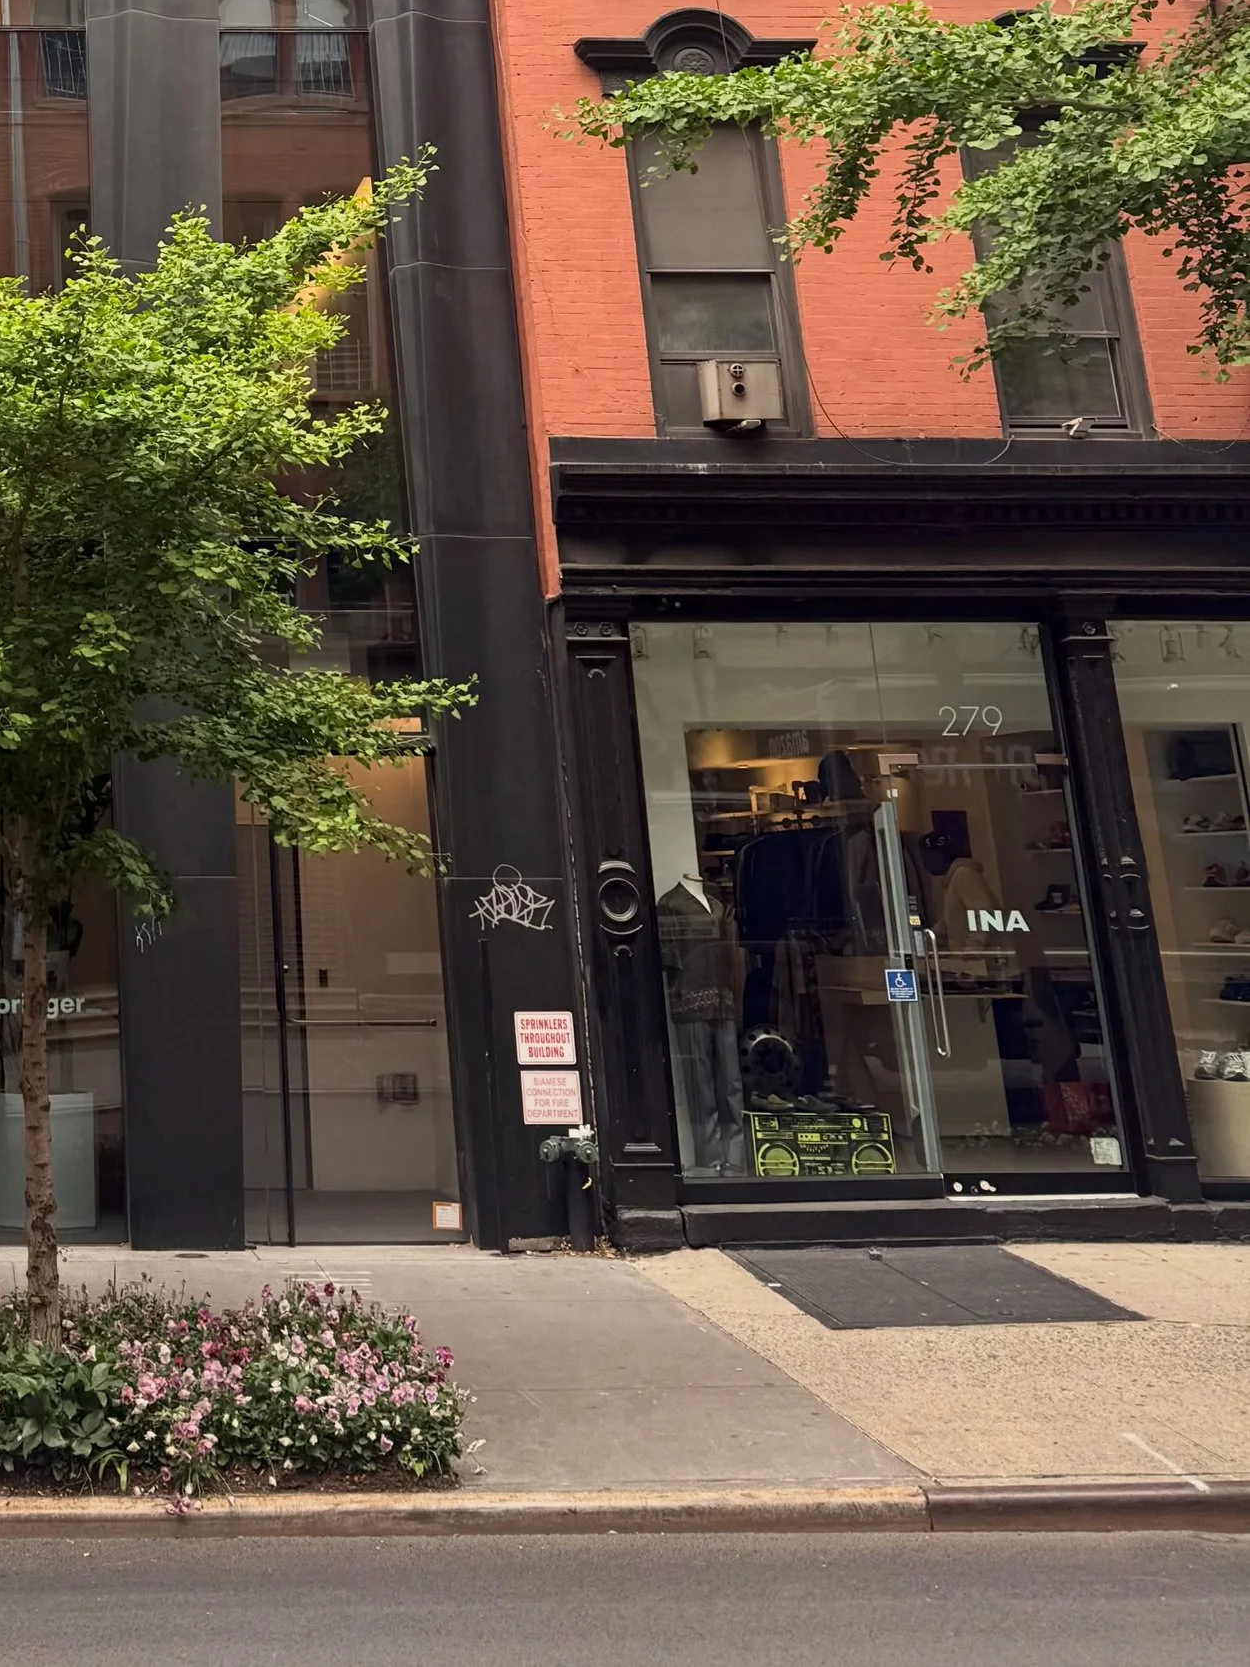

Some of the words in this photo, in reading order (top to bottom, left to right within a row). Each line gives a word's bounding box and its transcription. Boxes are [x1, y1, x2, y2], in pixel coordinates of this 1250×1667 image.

[939, 706, 1003, 736] 279
[966, 909, 1031, 932] INA
[520, 1018, 568, 1030] SPRINKLERS
[519, 1032, 570, 1044] THROUGHOUT
[528, 1046, 565, 1058] BUILDING
[533, 1077, 567, 1086] SIAMESE
[526, 1088, 576, 1097] CONNECTION
[534, 1098, 550, 1107] FOR
[552, 1098, 570, 1107] FIRE
[527, 1109, 578, 1118] DEPARTMENT
